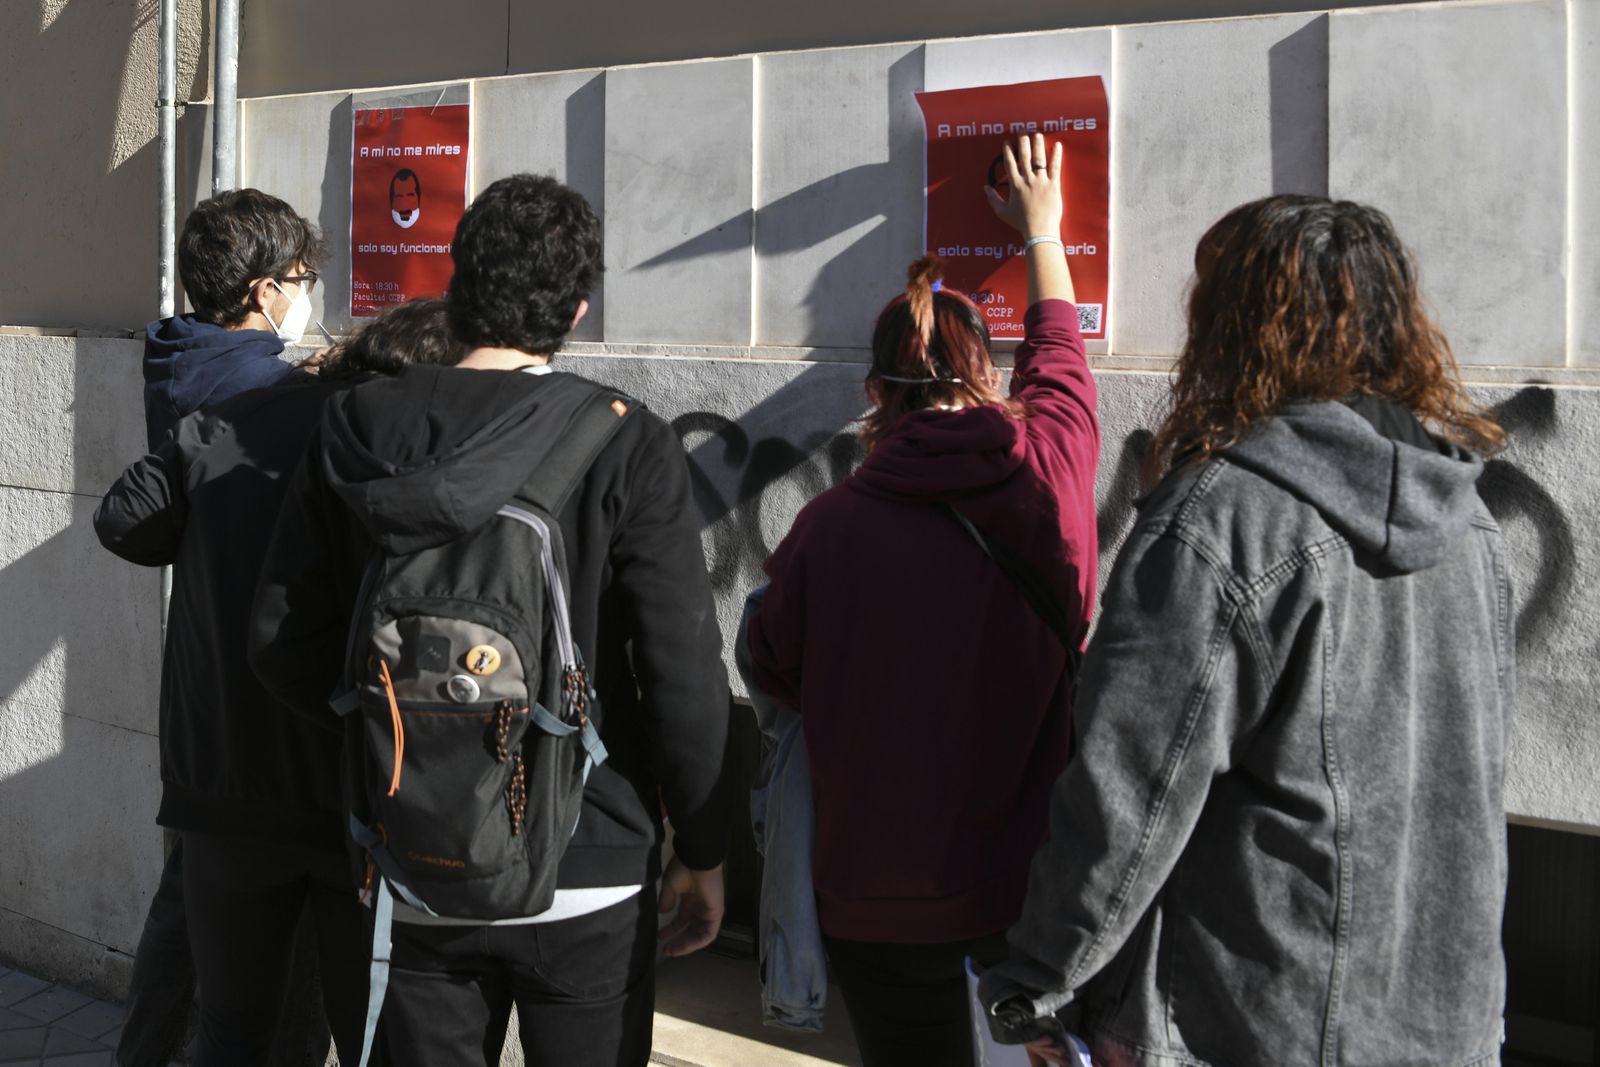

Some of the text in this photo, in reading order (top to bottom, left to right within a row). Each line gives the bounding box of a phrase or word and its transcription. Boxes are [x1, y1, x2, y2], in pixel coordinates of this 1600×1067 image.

[937, 116, 1097, 137] A mi no me mires
[360, 143, 461, 157] A mi no me mires
[358, 243, 452, 255] solo soy funcionari
[938, 242, 1097, 259] solo soy fuario
[997, 293, 1005, 304] h
[986, 307, 1014, 318] CCPP
